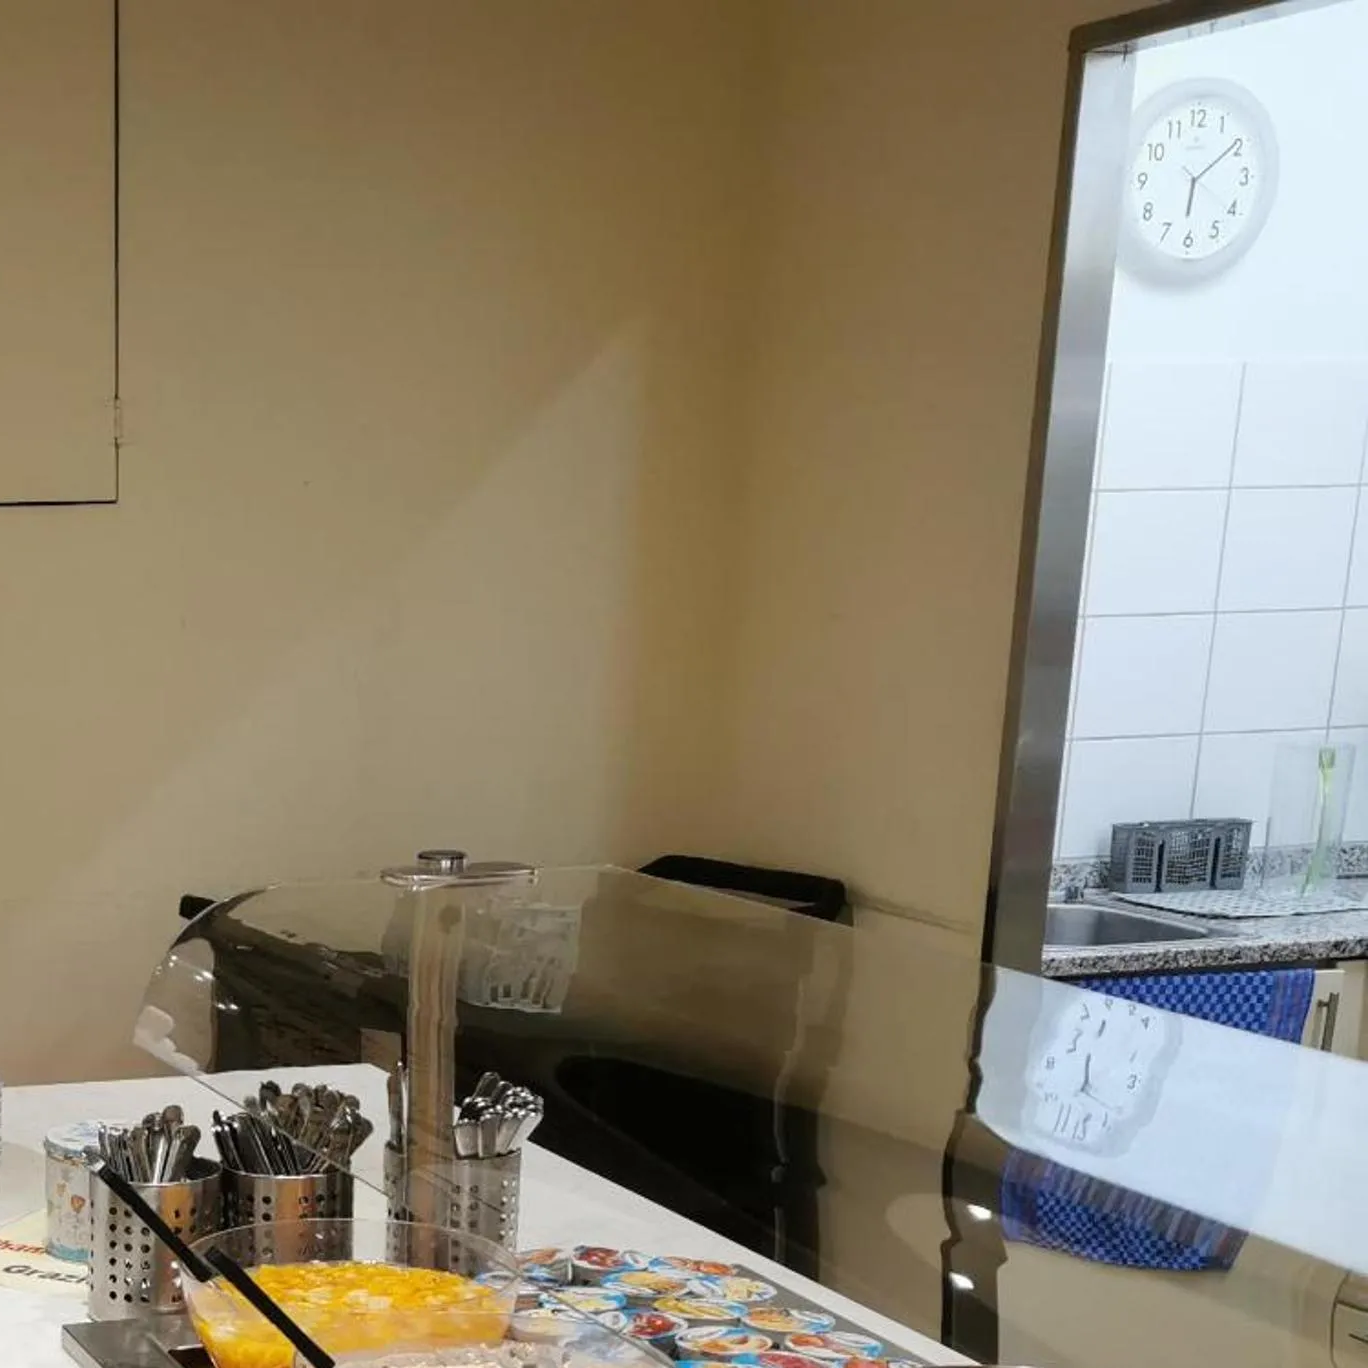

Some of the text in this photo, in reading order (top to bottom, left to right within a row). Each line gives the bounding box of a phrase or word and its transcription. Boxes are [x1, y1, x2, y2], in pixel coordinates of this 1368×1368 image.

[1190, 108, 1207, 128] 12
[1219, 115, 1225, 134] 1
[1168, 119, 1182, 140] 11
[1148, 142, 1165, 162] 10
[1233, 137, 1244, 157] 2
[1137, 172, 1149, 191] 9
[1239, 166, 1250, 187] 3
[1142, 201, 1154, 222] 8
[1226, 199, 1238, 217] 4
[1159, 221, 1173, 244] 7
[1182, 229, 1194, 248] 6
[1208, 219, 1220, 240] 5
